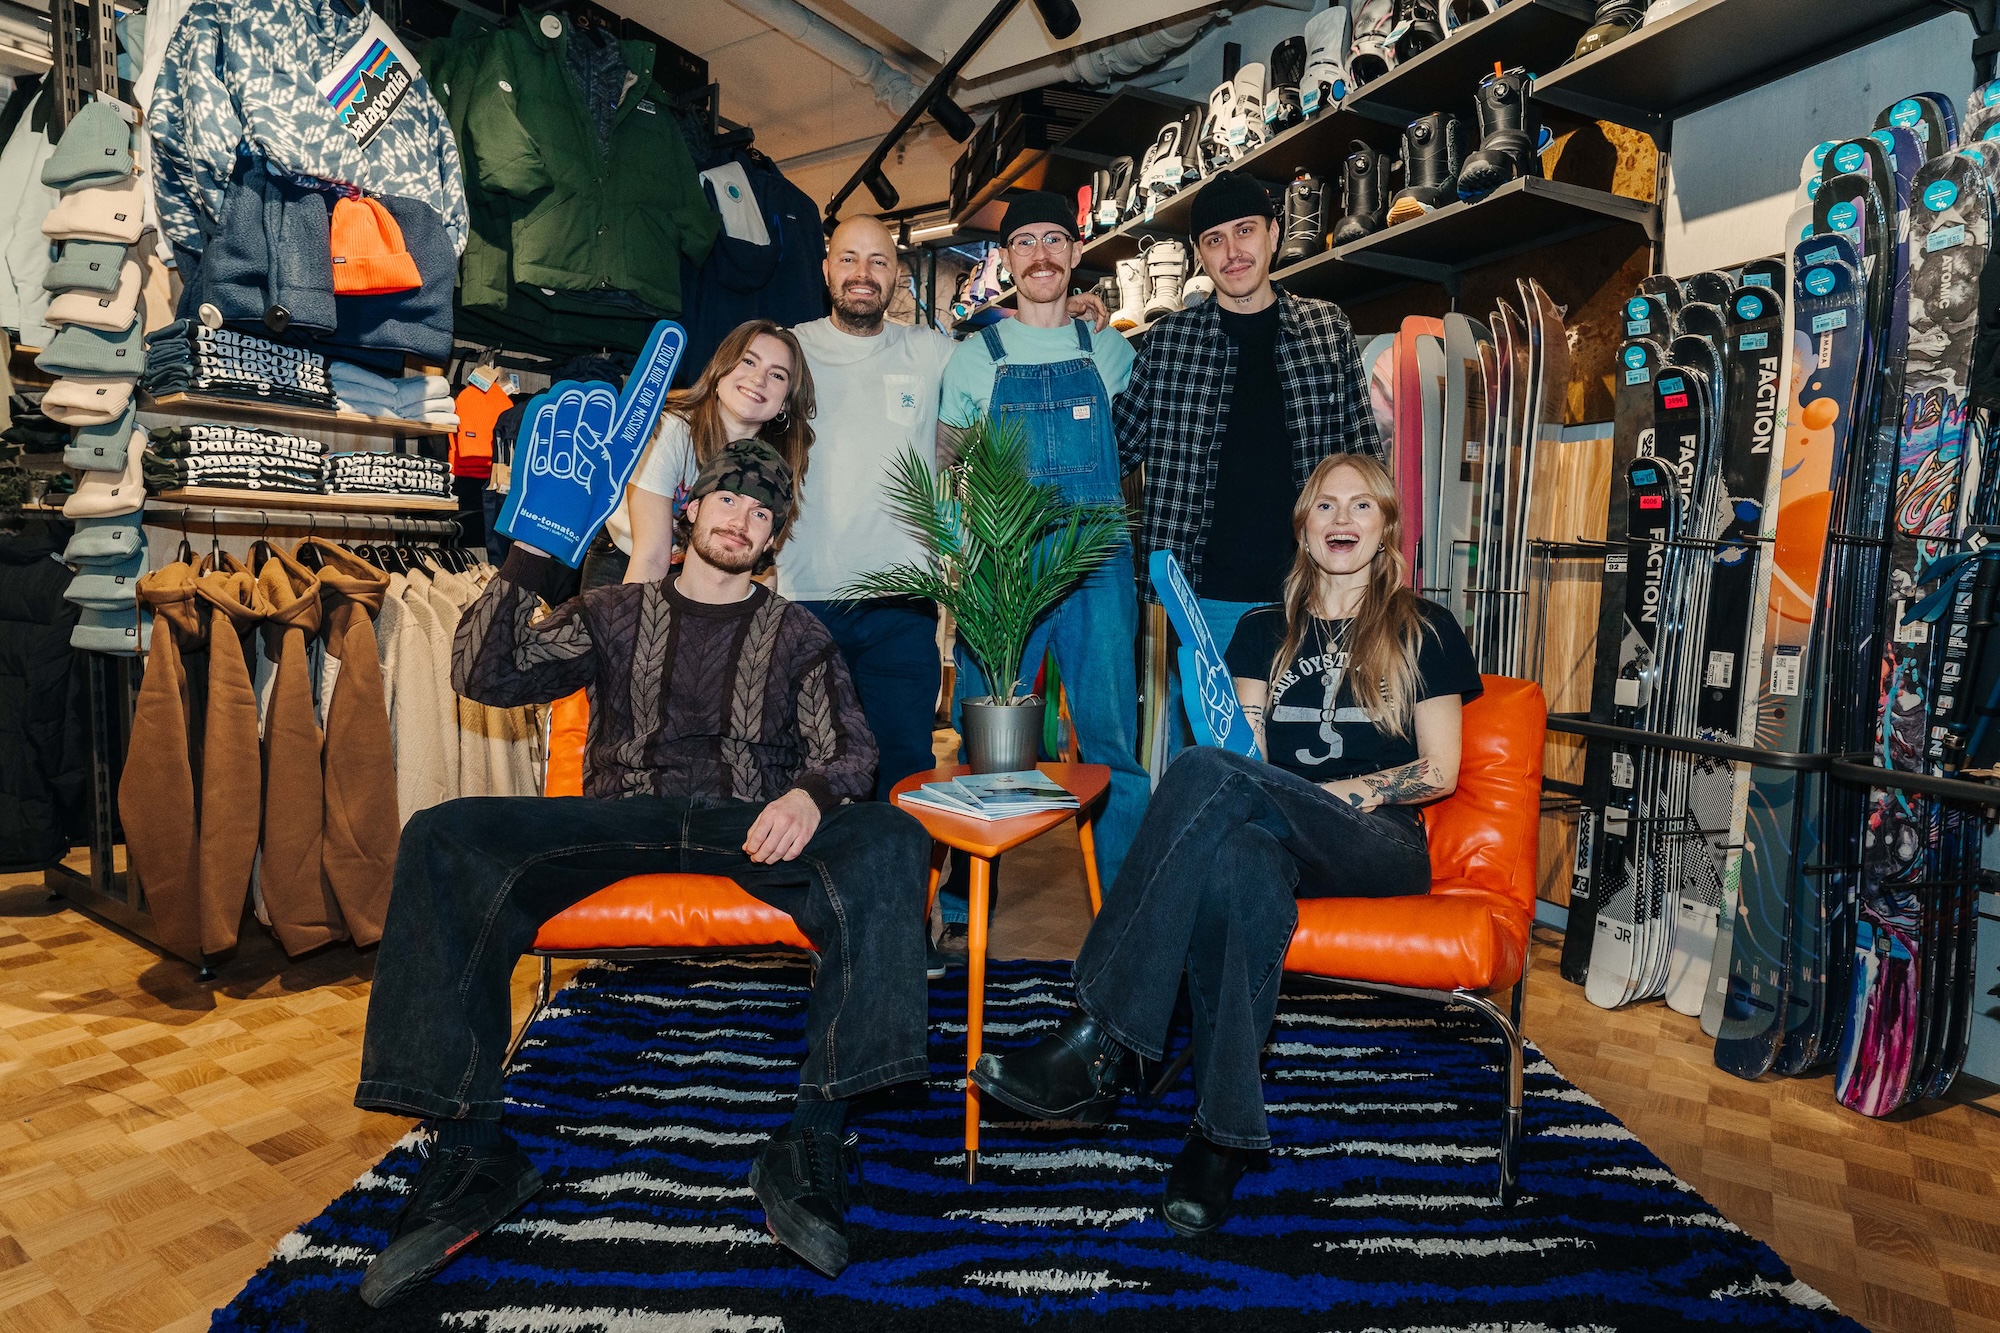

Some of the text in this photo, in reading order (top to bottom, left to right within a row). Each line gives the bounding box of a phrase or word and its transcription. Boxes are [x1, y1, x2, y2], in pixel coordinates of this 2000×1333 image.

[1938, 254, 1954, 310] ATOMIC
[197, 324, 325, 369] patagonia
[1821, 331, 1831, 364] RMADA
[620, 343, 676, 444] YOUR RIDE. OUR MISSION.
[1750, 356, 1778, 454] FACTION
[188, 426, 322, 455] patagonia
[335, 454, 444, 473] patagonia
[1608, 563, 1620, 571] 92
[1640, 527, 1666, 623] FACTION
[1297, 651, 1361, 677] ÖYST
[1614, 926, 1632, 944] JR
